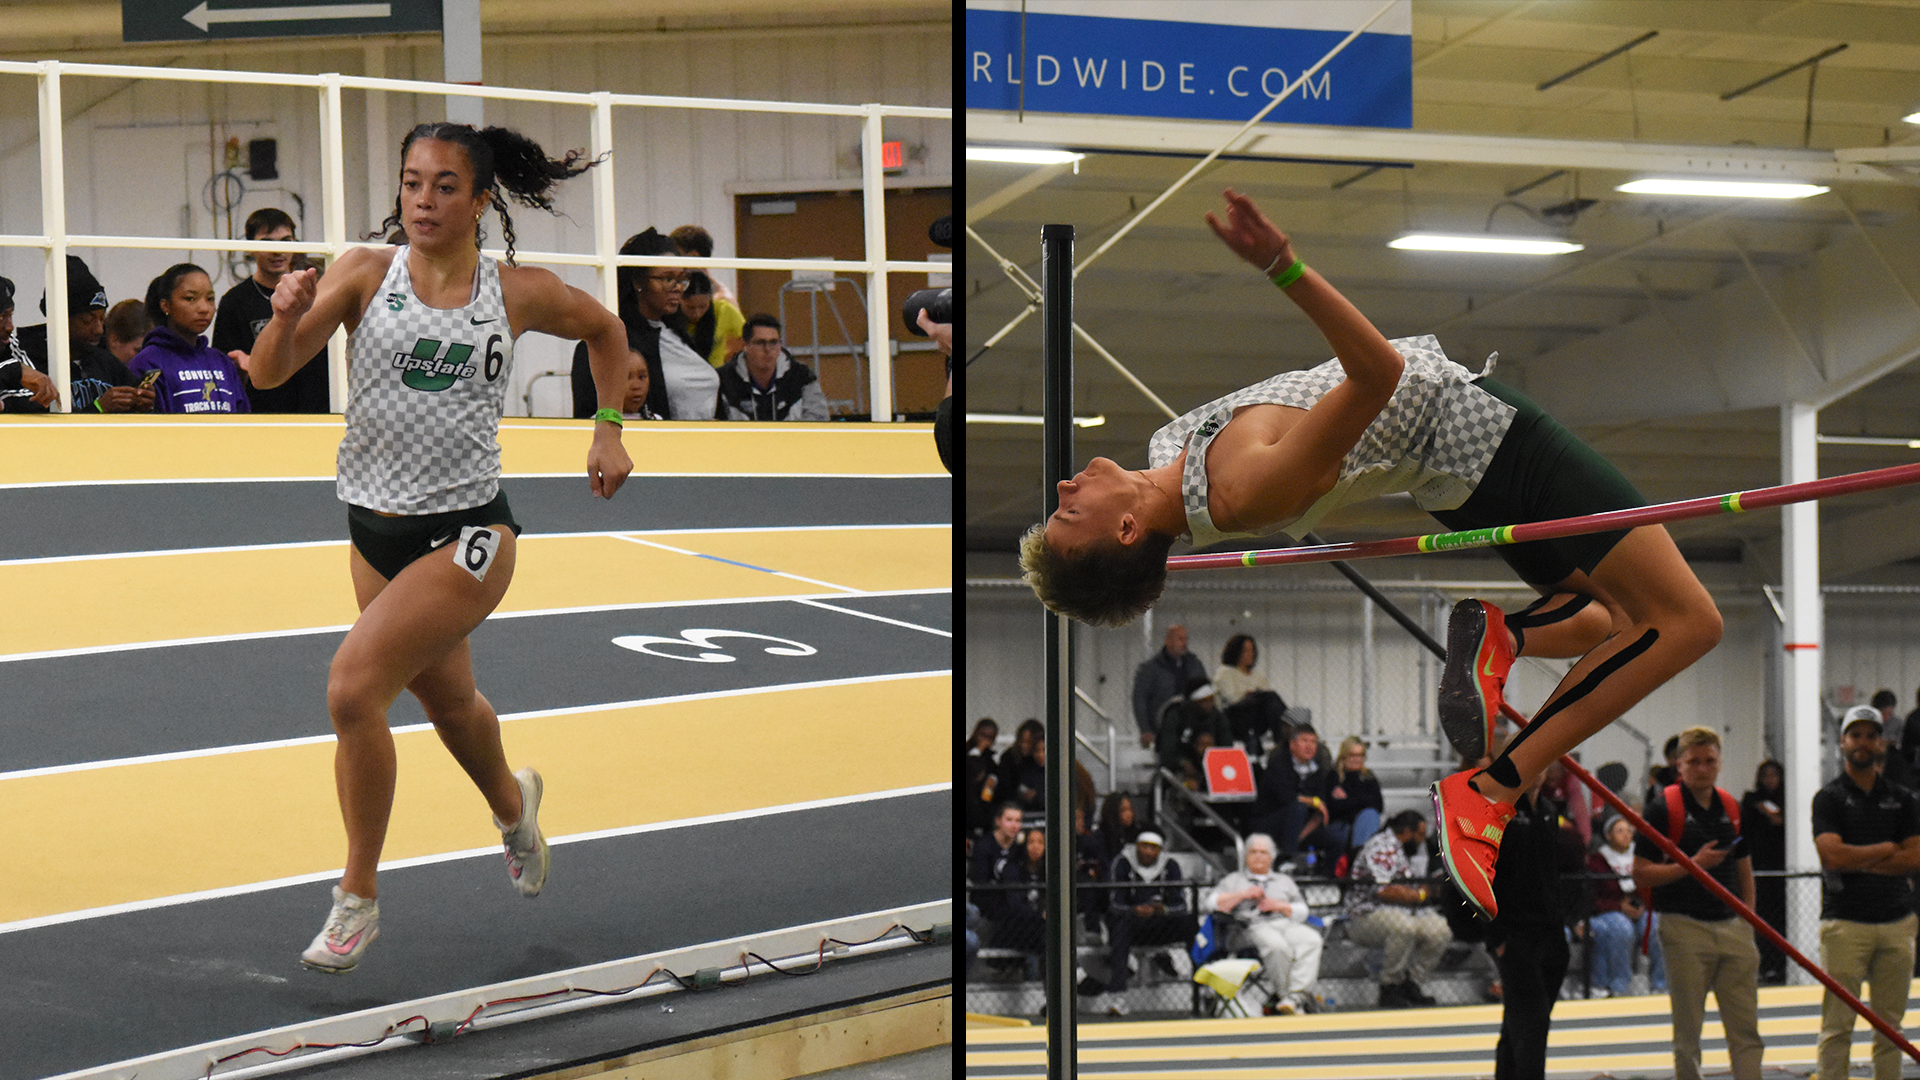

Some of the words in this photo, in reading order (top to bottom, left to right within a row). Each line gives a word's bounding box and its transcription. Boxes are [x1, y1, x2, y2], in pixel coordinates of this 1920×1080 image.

[973, 51, 1331, 101] RLDWIDE.COM
[392, 352, 477, 379] Upstate
[485, 333, 503, 382] 6
[184, 401, 210, 413] TRACK
[465, 530, 492, 571] 6
[611, 628, 818, 662] 3
